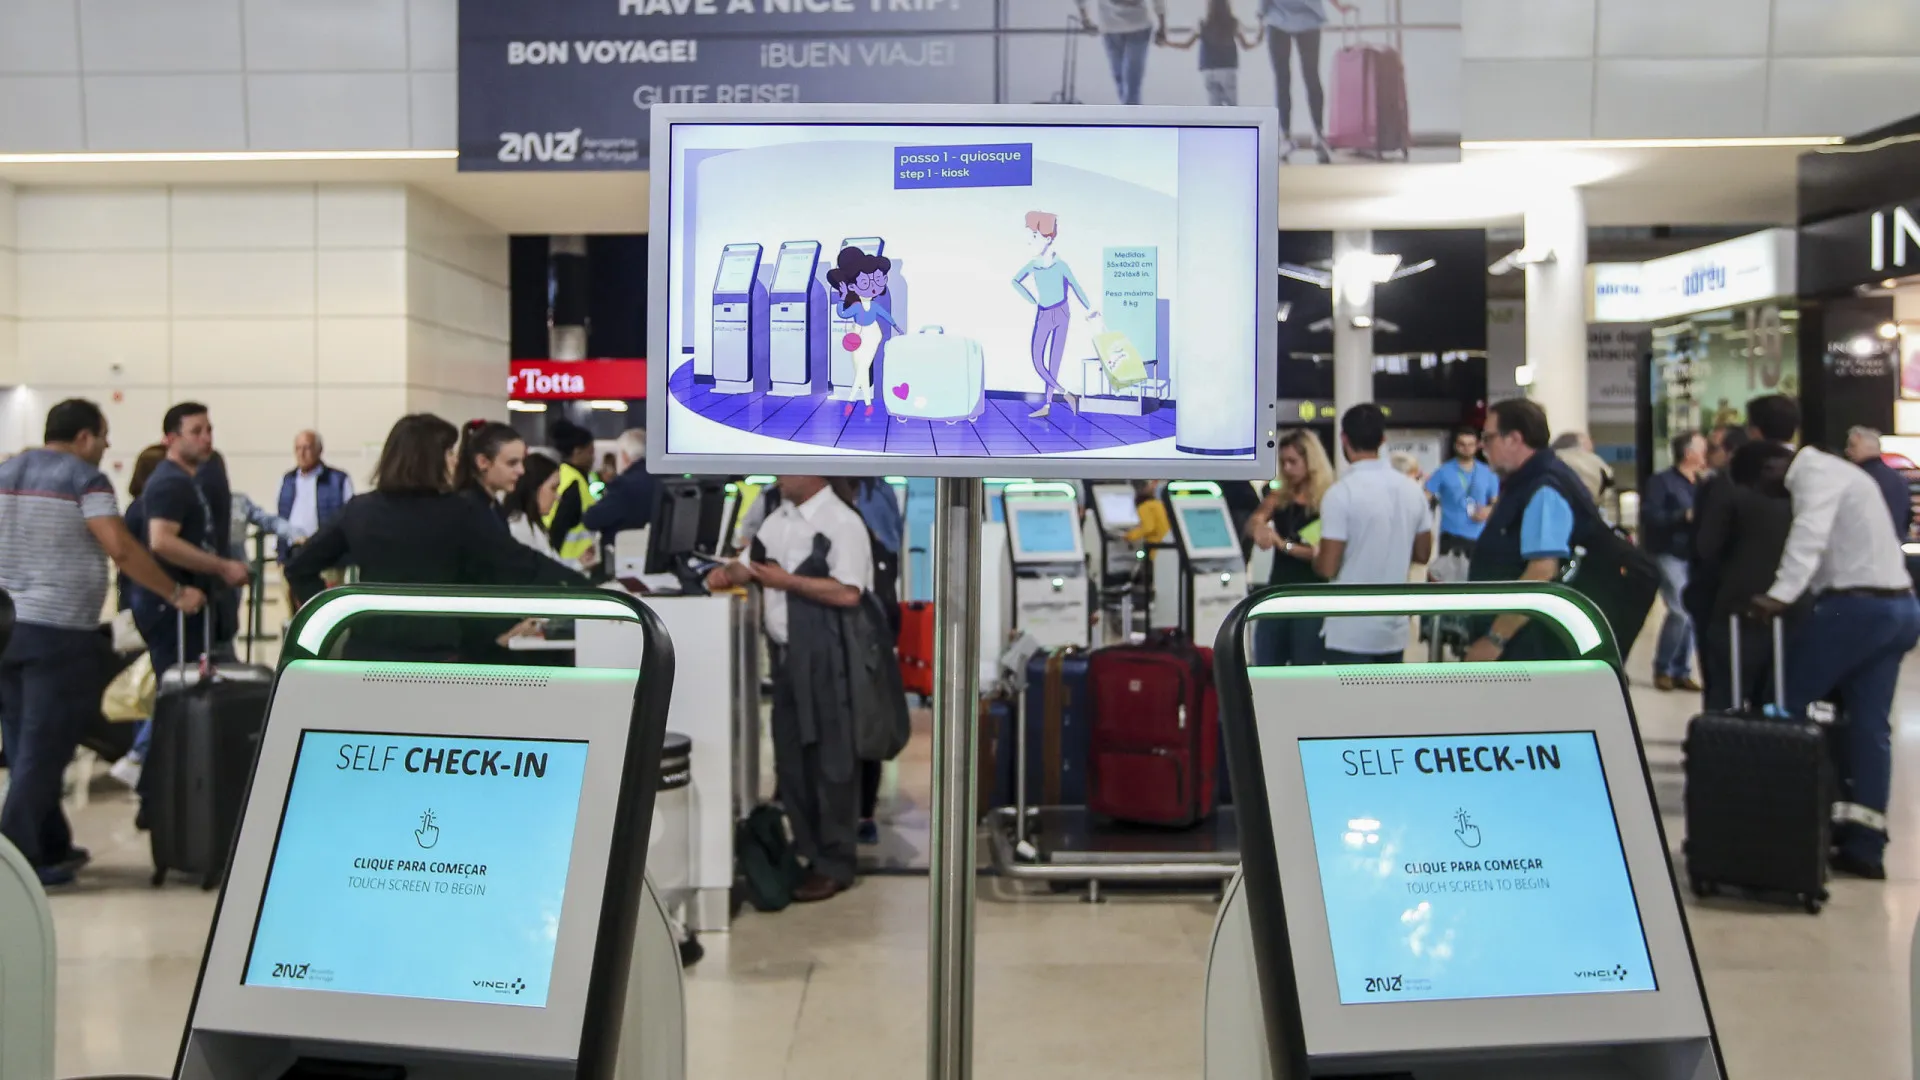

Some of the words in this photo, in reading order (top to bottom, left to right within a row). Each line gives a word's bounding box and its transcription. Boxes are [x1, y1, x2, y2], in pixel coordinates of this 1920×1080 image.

[619, 0, 718, 15] HAVE
[727, 0, 755, 14] A
[764, 0, 855, 13] NICE
[507, 41, 569, 64] BON
[574, 40, 698, 64] VOYAGE!
[760, 42, 851, 68] ¡BUEN
[857, 41, 956, 66] VIAJE!
[633, 85, 710, 109] GUTE
[900, 154, 939, 166] passo
[943, 152, 948, 162] 1
[960, 151, 1021, 164] quiosque
[900, 169, 924, 180] step
[927, 169, 931, 178] 1
[941, 168, 969, 178] kiosk
[1124, 289, 1153, 297] máximo
[519, 368, 585, 394] Totta
[336, 744, 399, 772] SELF
[405, 747, 549, 778] CHECK-IN
[1342, 749, 1405, 776] SELF
[1414, 744, 1561, 774] CHECK-IN
[353, 858, 395, 872] CLIQUE
[397, 860, 426, 872] PARA
[430, 862, 487, 878] COMEÇAR
[1405, 861, 1447, 876] CLIQUE
[1450, 860, 1481, 873] PARA
[1484, 858, 1543, 874] COMEÇAR
[347, 876, 386, 889] TOUCH
[388, 878, 430, 892] SCREEN
[434, 881, 449, 893] TO
[451, 882, 486, 896] BEGIN
[1406, 881, 1447, 894] TOUCH
[1449, 879, 1493, 893] SCREEN
[1497, 879, 1512, 891] TO
[1514, 877, 1550, 890] BEGIN
[1574, 970, 1610, 979] VINCI
[472, 980, 508, 990] VINCI
